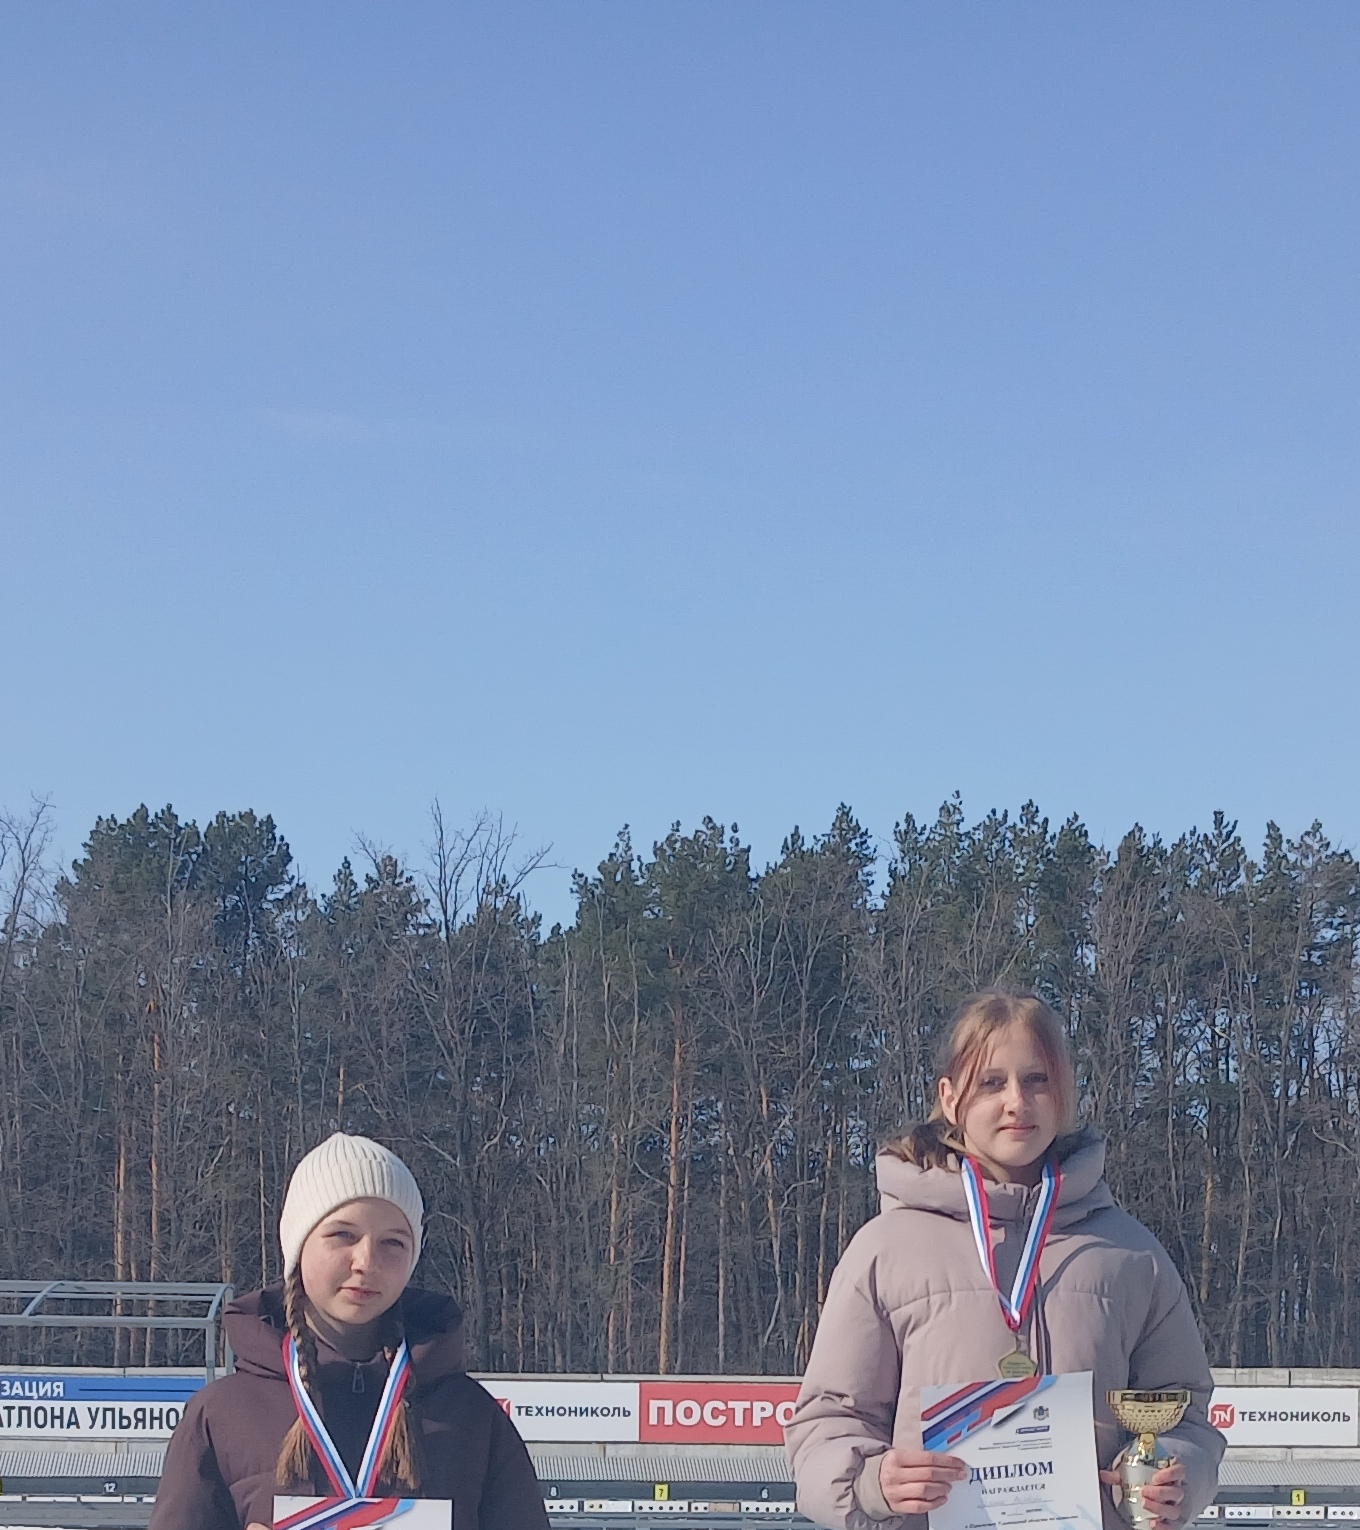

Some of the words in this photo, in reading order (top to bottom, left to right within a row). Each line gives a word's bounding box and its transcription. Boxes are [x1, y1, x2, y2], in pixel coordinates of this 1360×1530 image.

[87, 1406, 186, 1431] УЛЬЯНО
[515, 1405, 632, 1418] ТЕХНОНИКОЛЬ
[1239, 1411, 1351, 1422] ТЕХНОНИКОЛЬ
[969, 1461, 1054, 1485] ДИПЛОМ
